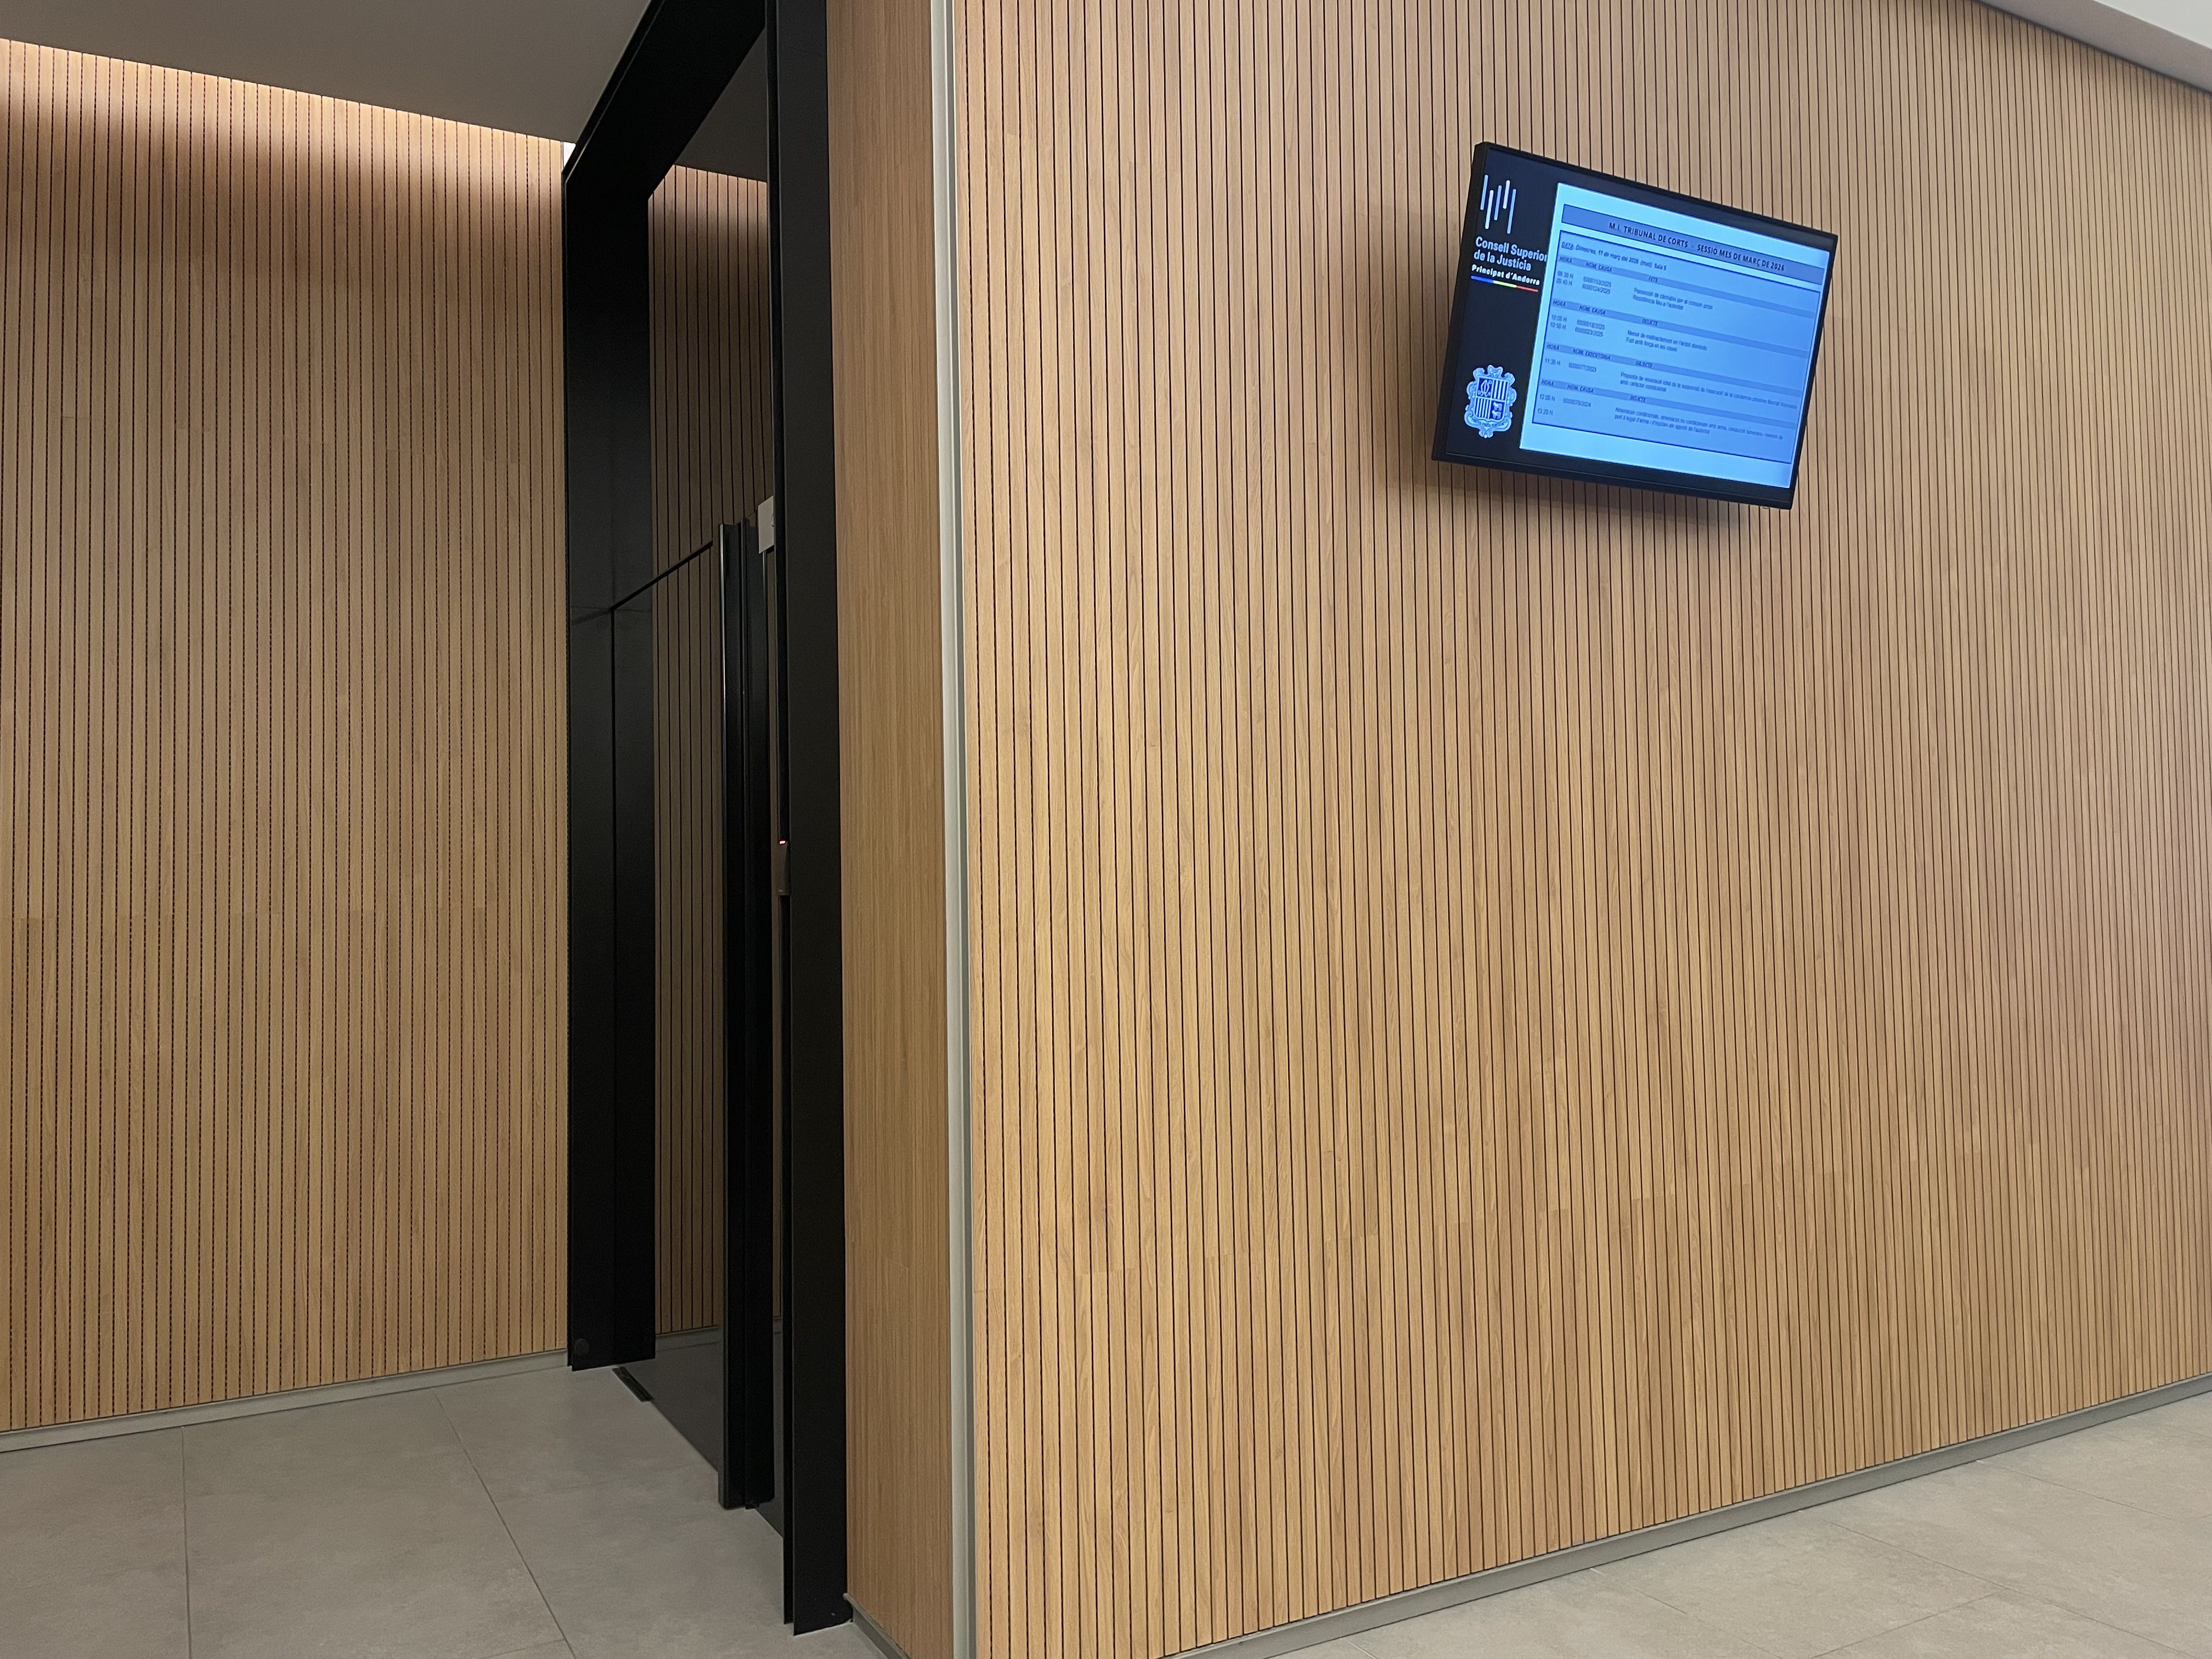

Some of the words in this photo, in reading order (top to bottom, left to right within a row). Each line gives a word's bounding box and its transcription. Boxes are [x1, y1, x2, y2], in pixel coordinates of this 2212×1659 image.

[1475, 236, 1509, 253] Consell
[1510, 244, 1547, 262] Superior
[1609, 222, 1621, 232] M.I.
[1624, 226, 1656, 240] TRIBUNAL
[1658, 234, 1666, 242] DE
[1668, 237, 1688, 248] CORTS
[1697, 244, 1717, 255] SESSIÓ
[1719, 249, 1731, 258] MES
[1742, 256, 1760, 267] MARÇ
[1771, 262, 1784, 271] 2026
[1471, 264, 1504, 278] Principat
[1474, 249, 1485, 261] de
[1487, 252, 1495, 263] la
[1497, 255, 1531, 271] Justícia
